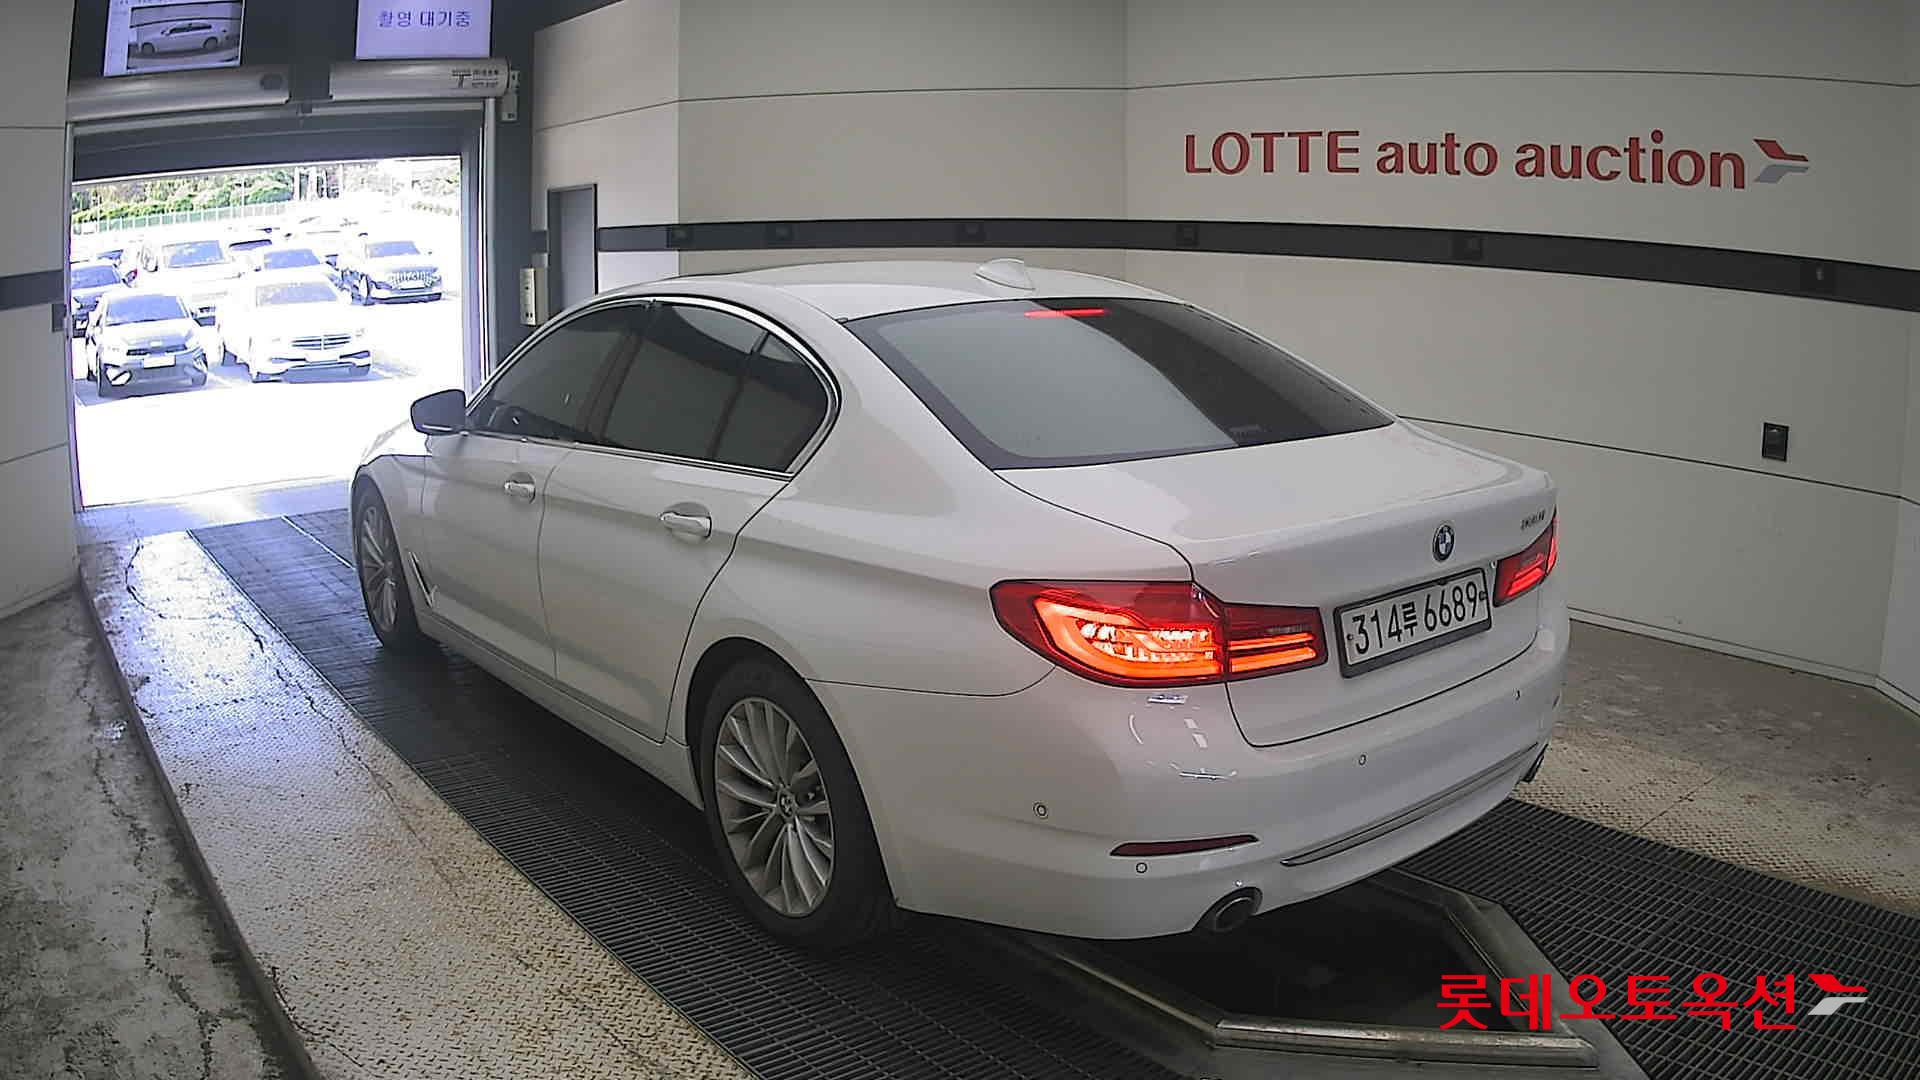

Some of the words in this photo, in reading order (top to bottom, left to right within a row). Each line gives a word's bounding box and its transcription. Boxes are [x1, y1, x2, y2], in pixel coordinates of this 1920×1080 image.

[420, 10, 471, 28] 대기중
[1184, 130, 1361, 175] LOTTE
[1376, 132, 1499, 177] auto
[1514, 129, 1746, 189] auction
[1352, 601, 1418, 655] 314루
[1423, 581, 1478, 632] 6689
